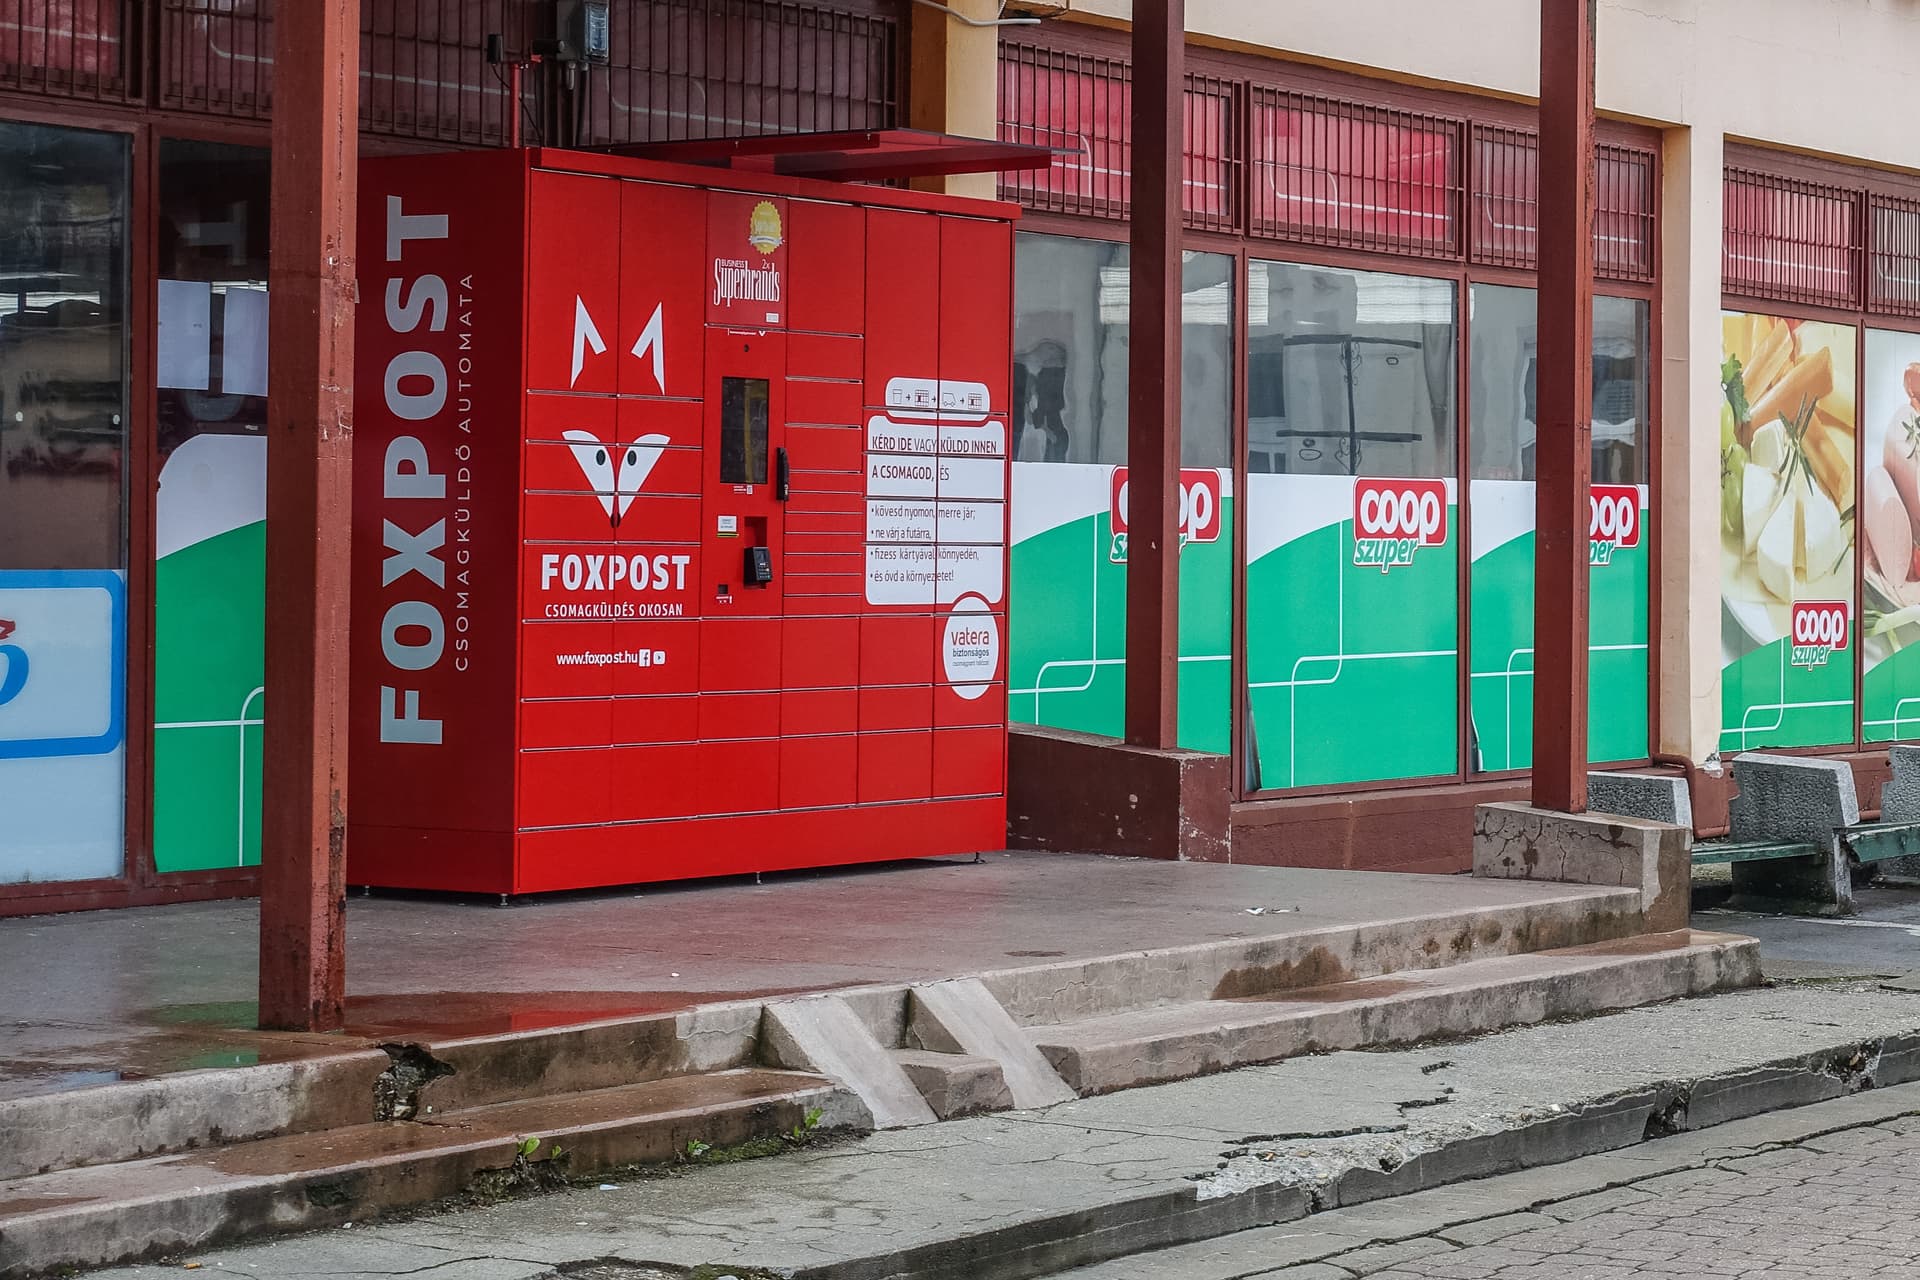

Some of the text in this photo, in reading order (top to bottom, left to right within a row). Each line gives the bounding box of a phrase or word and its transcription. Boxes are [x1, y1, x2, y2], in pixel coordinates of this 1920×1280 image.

[713, 258, 780, 307] Superbrands
[458, 274, 473, 433] AUTOMATA
[872, 434, 997, 454] KÉRD IDE VAGY KÜLDD INNEN
[381, 195, 448, 744] FOXPOST
[871, 464, 950, 481] A CSOMAGOD, ÉS
[874, 505, 904, 518] kövesd
[937, 508, 961, 519] merre
[875, 527, 932, 540] ne várj a futárra,
[874, 548, 897, 560] fizess
[1354, 539, 1418, 572] szuper
[541, 554, 691, 591] FOXPOST
[874, 569, 883, 582] és
[884, 569, 899, 582] óvd
[906, 569, 955, 585] környezetet!
[545, 601, 683, 617] CSOMAGKÜLDÉS OKOSAN
[951, 627, 990, 646] vatera
[556, 650, 638, 667] www.foxpost.hu
[952, 647, 989, 658] biztonságos
[1792, 646, 1831, 670] szuper
